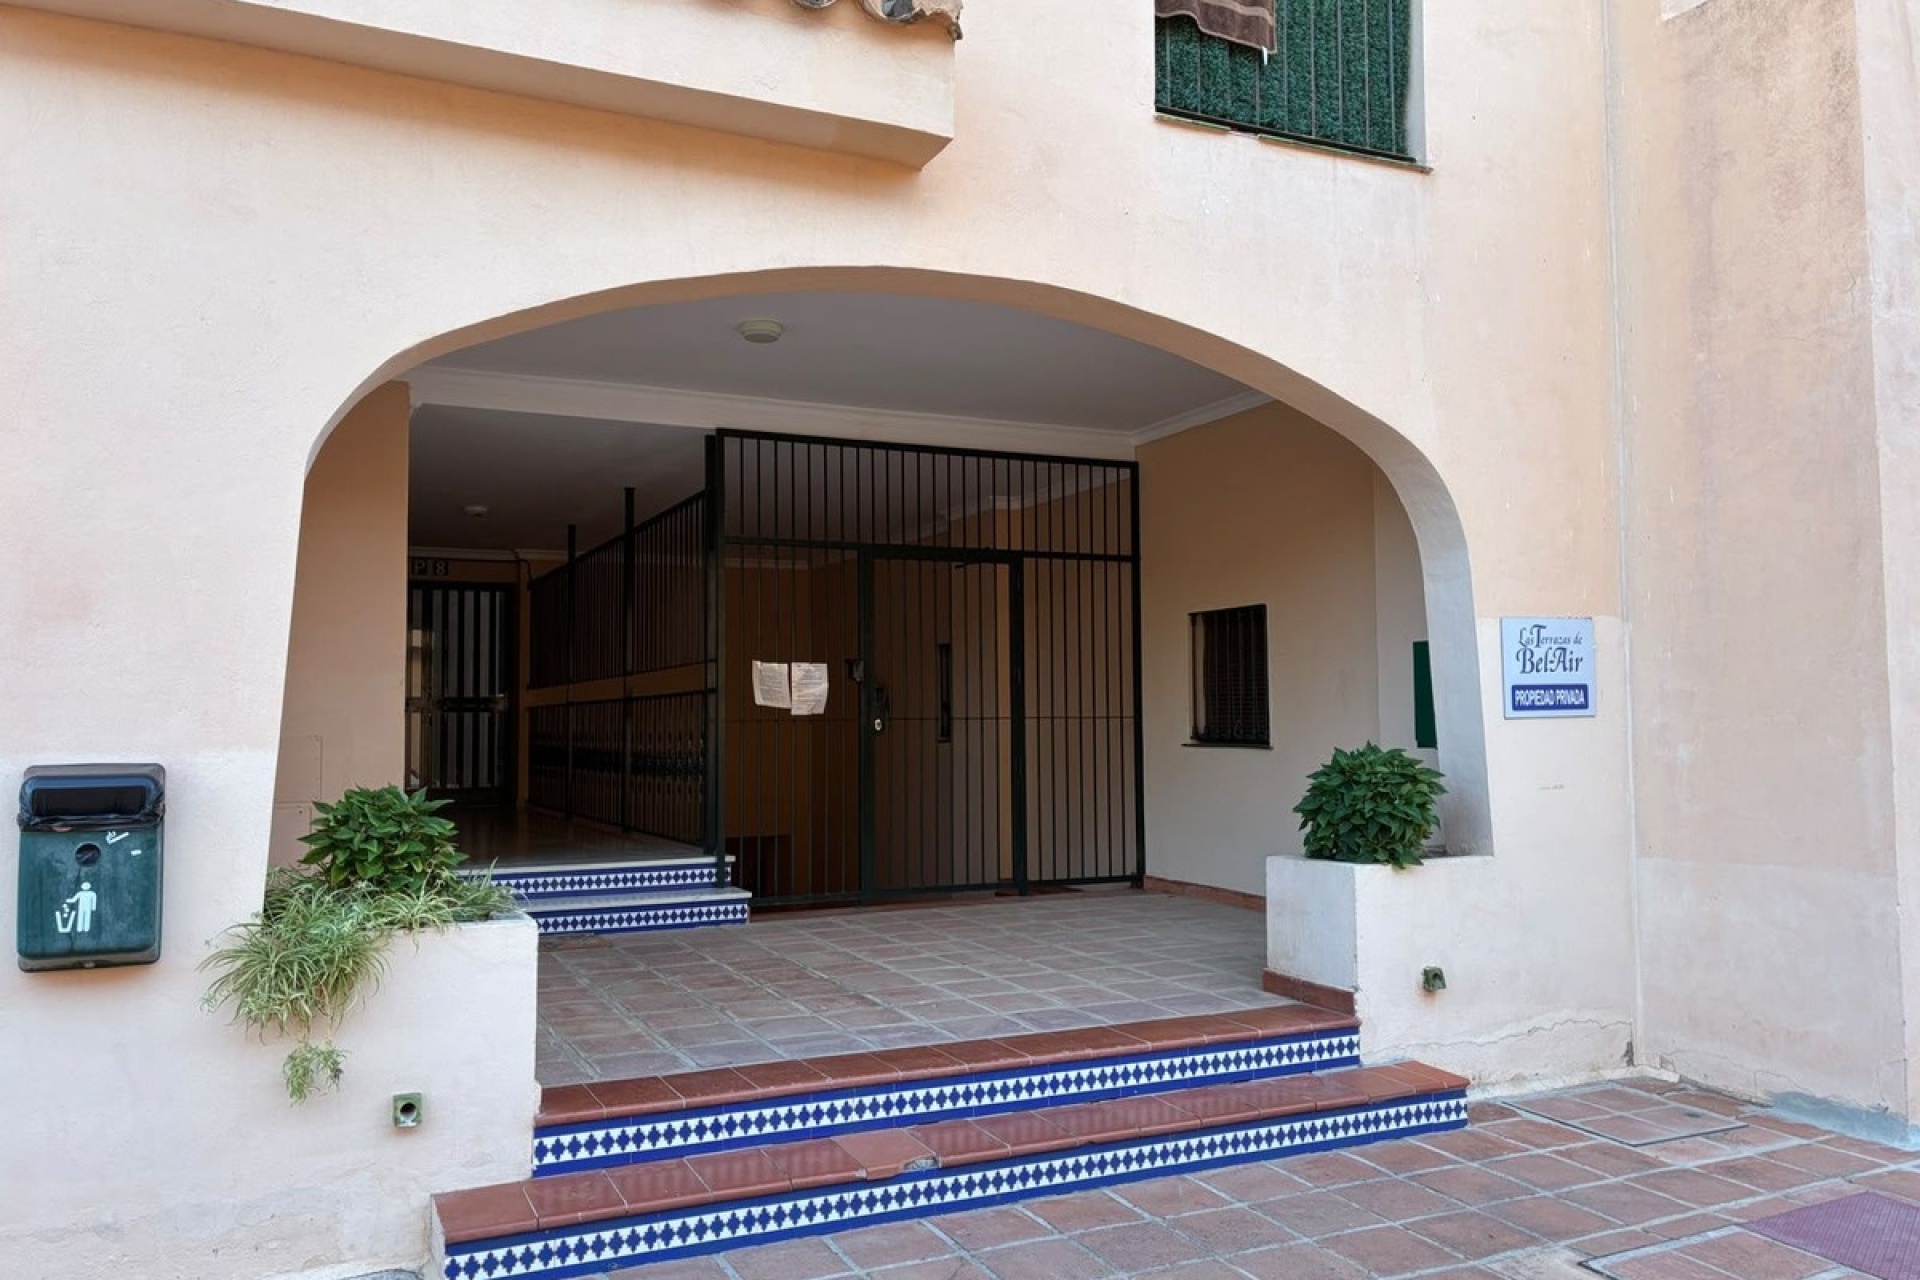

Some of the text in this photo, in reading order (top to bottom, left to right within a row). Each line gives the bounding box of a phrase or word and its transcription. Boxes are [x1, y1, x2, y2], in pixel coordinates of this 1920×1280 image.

[1518, 624, 1583, 648] Las Terrazas de
[1516, 689, 1585, 706] PROPIEDAD PRIVADA
